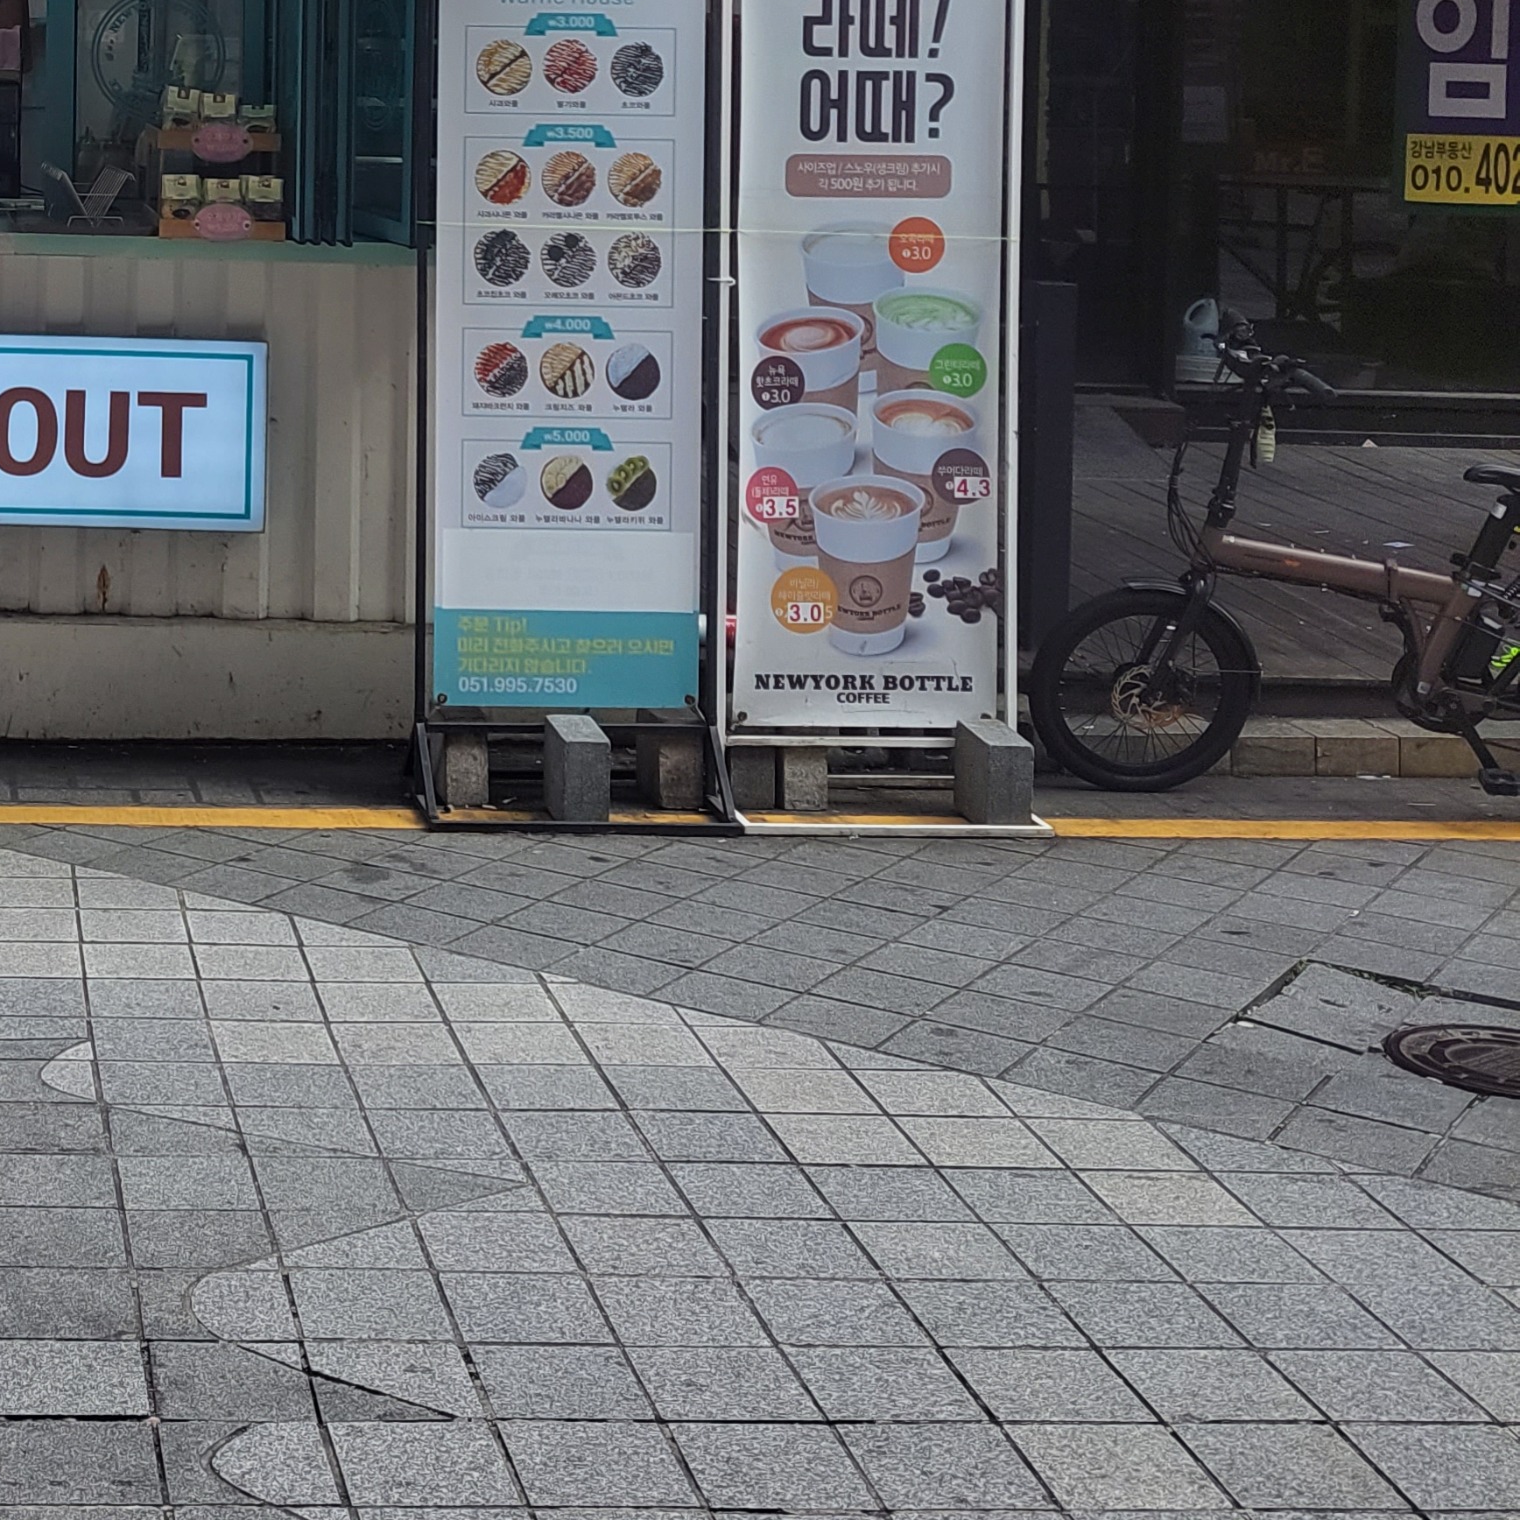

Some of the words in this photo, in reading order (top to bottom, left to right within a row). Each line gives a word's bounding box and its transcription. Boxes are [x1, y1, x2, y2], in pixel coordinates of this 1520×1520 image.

[799, 68, 955, 143] 어때?
[1410, 140, 1472, 159] 강남부동산
[798, 162, 836, 175] 사이즈업
[911, 163, 940, 175] 추가시
[818, 179, 829, 191] 각
[830, 178, 863, 191] 500원
[865, 179, 885, 191] 추가
[887, 179, 919, 192] 됩니다.
[911, 247, 931, 260] 3.0
[769, 364, 785, 376] 뉴욕
[951, 373, 973, 387] 3.0
[770, 389, 790, 403] 3.0
[762, 474, 777, 486] 연유
[957, 479, 990, 497] 4.3
[765, 498, 796, 516] 3.5
[790, 604, 821, 622] 3.0
[495, 617, 527, 633] Tip!
[458, 638, 489, 653] 미리
[458, 658, 519, 673] 기다리지
[458, 676, 577, 694] 051.995.7530
[754, 673, 875, 691] NEWYORK
[882, 675, 973, 693] BOTTLE
[836, 692, 890, 705] COFFEE
